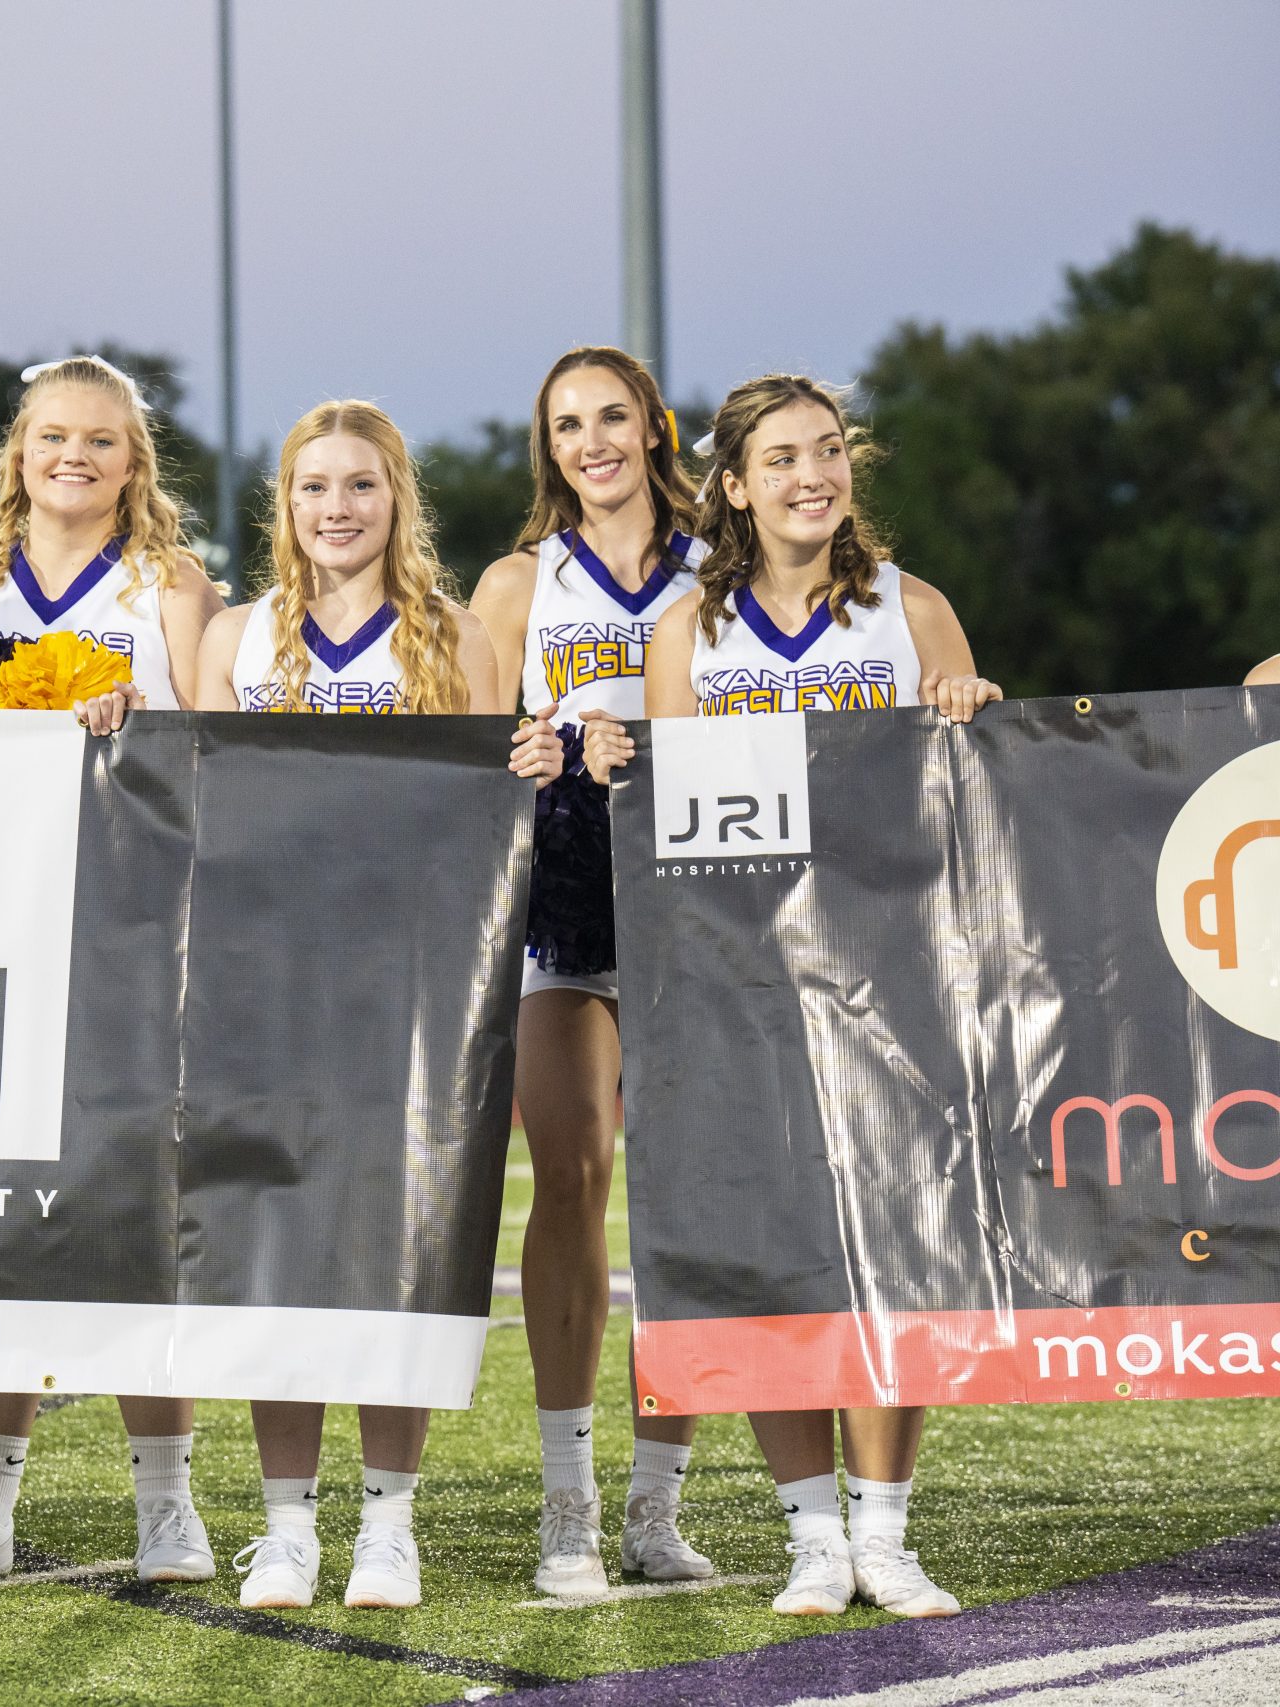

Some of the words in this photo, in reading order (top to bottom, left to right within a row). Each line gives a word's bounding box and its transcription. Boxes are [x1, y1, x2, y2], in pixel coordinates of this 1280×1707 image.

[542, 642, 651, 703] WESL
[702, 660, 894, 699] KANSAS
[243, 682, 409, 711] KNSA
[668, 793, 789, 843] JRI
[656, 860, 813, 878] HOSPITALITY
